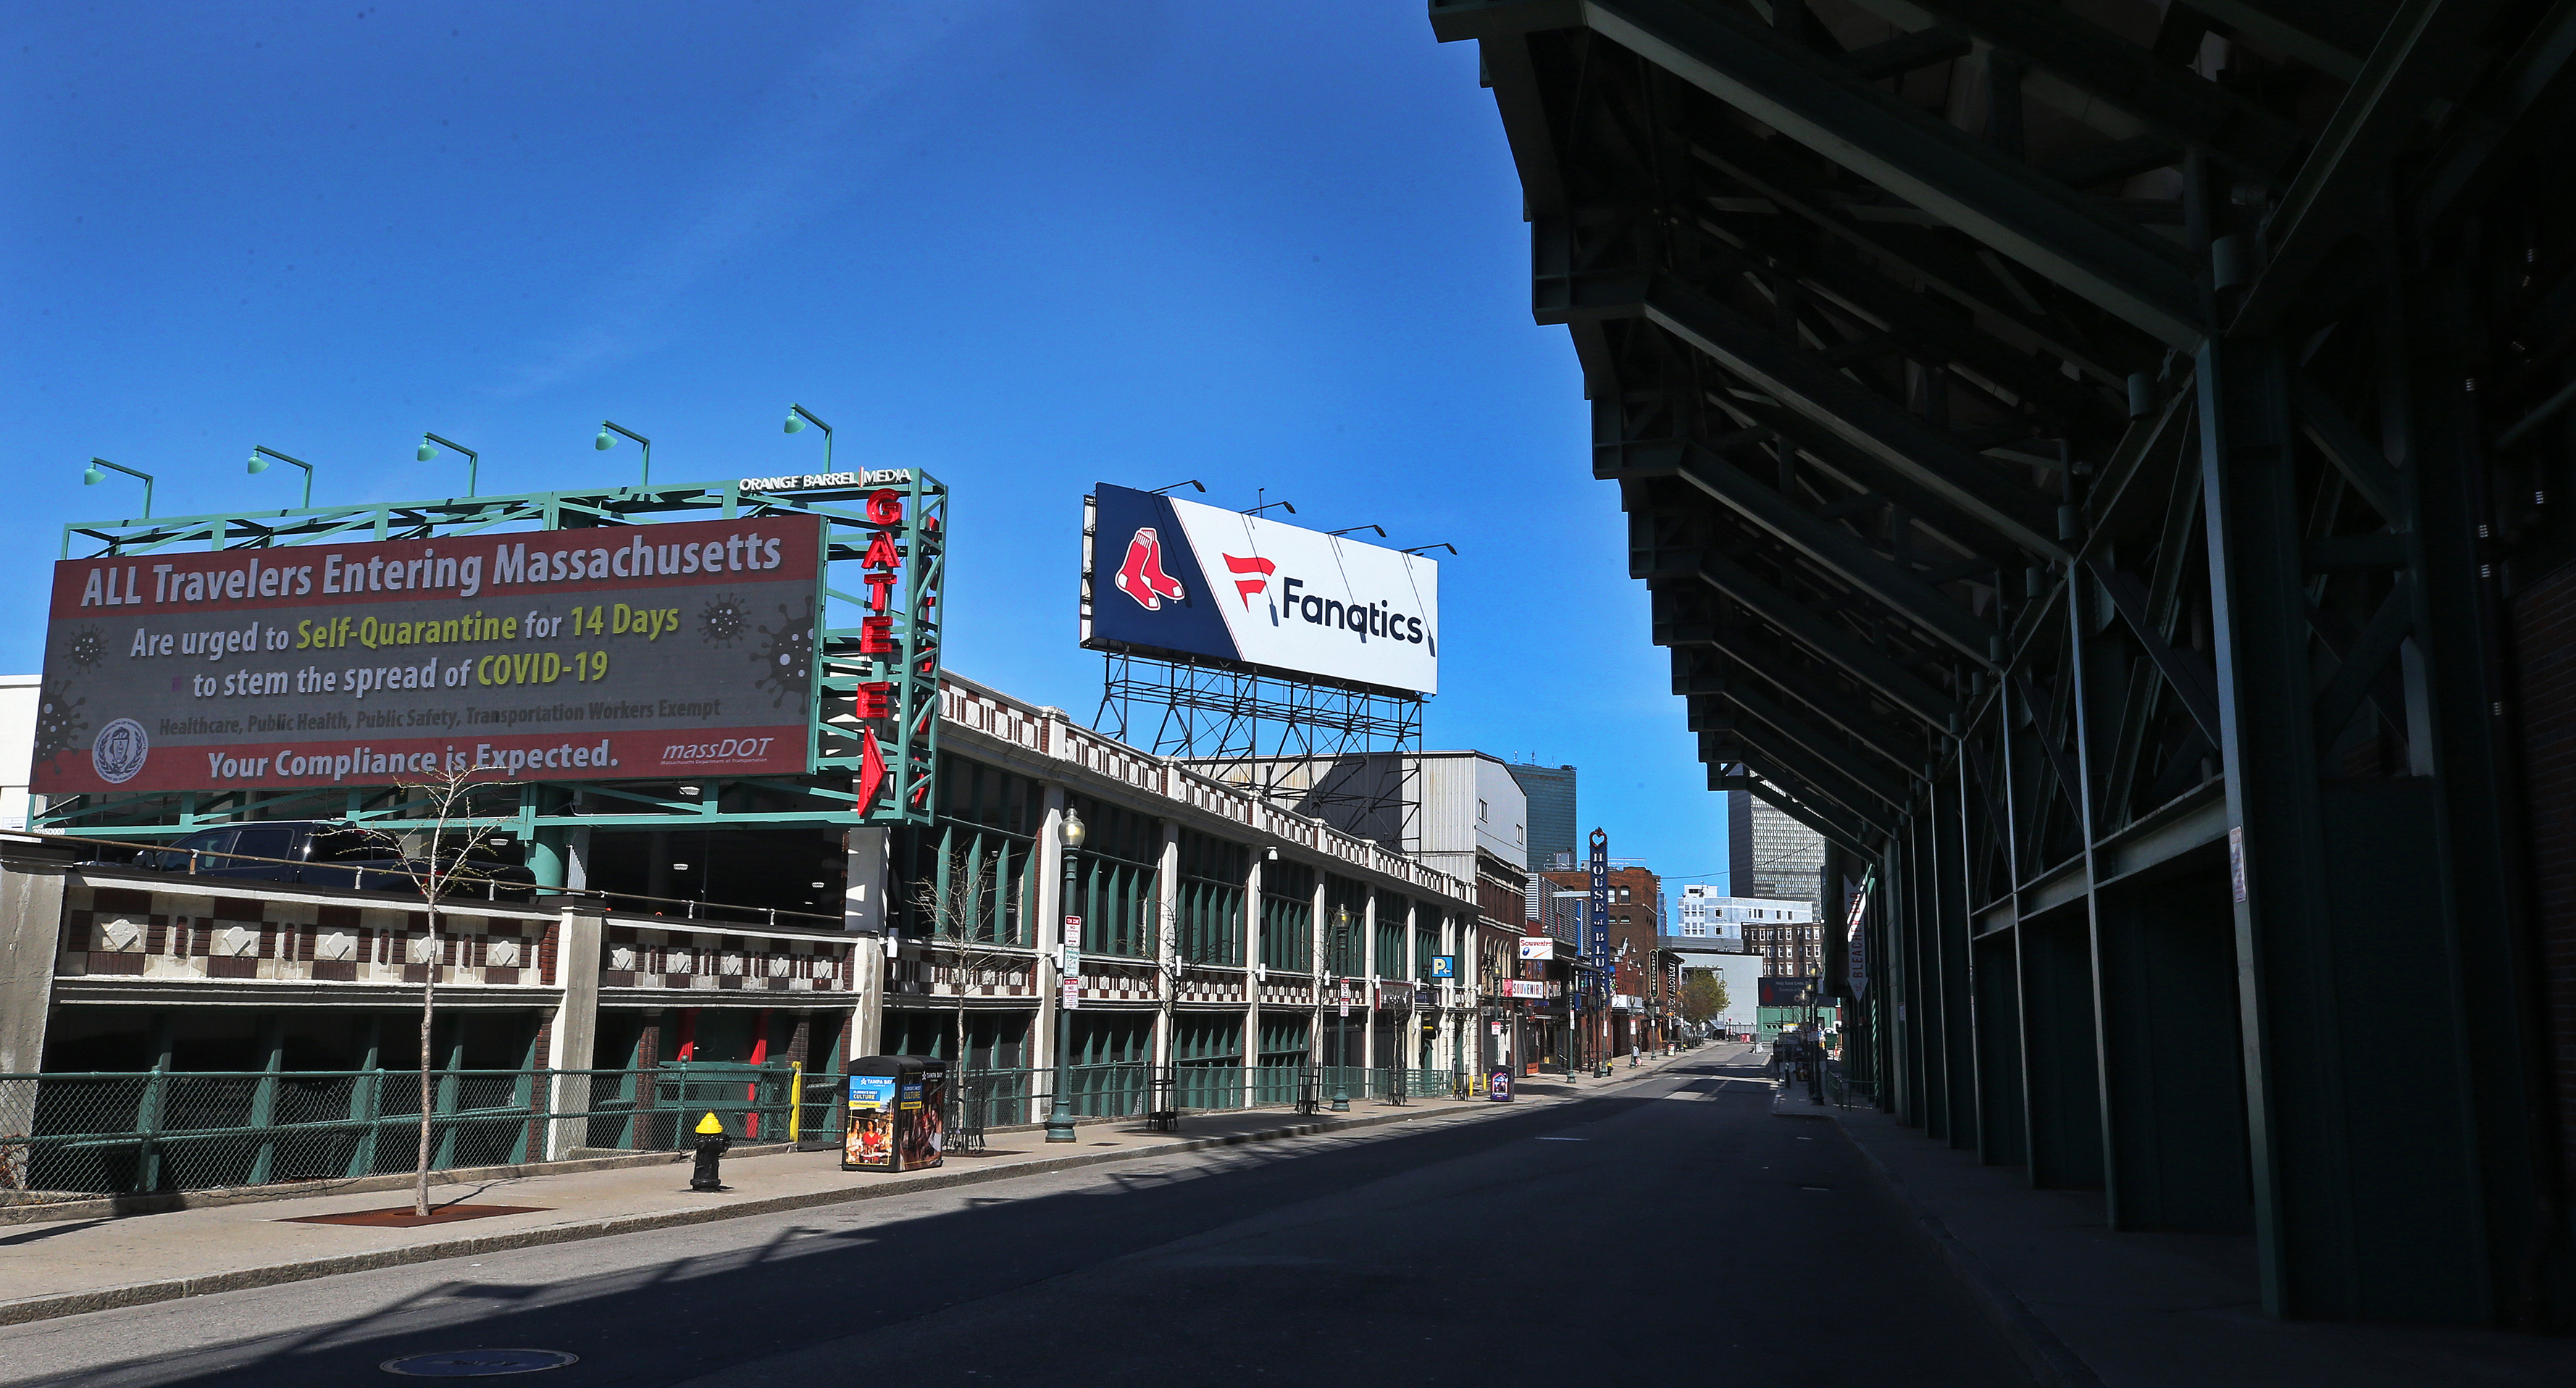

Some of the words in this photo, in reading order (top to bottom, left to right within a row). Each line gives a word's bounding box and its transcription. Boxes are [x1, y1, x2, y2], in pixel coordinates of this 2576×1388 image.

[740, 475, 802, 491] ORANGE
[803, 472, 860, 488] BARREL
[863, 468, 911, 484] MEDIA
[80, 566, 141, 607] ALL
[153, 558, 312, 603] Travelers
[322, 548, 482, 597] Entering
[493, 532, 782, 585] Massachusetts
[861, 488, 903, 653] GATE
[130, 627, 175, 657] Are
[181, 621, 259, 661] urged
[265, 627, 289, 651] to
[296, 611, 517, 651] Self-Quarantine
[524, 611, 562, 639] for
[570, 606, 603, 636] 14
[612, 603, 679, 641] Days
[1283, 576, 1423, 645] Fanatics
[193, 674, 217, 697] to
[224, 669, 288, 696] stem
[296, 666, 336, 693] the
[343, 657, 437, 698] spread
[444, 659, 472, 687] of
[477, 651, 608, 686] COVID-19
[159, 716, 243, 736] Healthcare,
[247, 713, 293, 733] Public
[296, 711, 351, 732] Health,
[357, 709, 404, 729] Public
[406, 707, 461, 729] Safety,
[466, 703, 584, 727] Transportation
[588, 700, 653, 721] Workers
[658, 698, 722, 720] Exempt
[856, 682, 890, 719] E
[208, 752, 269, 779] Your
[275, 747, 437, 782] Compliance
[445, 744, 467, 772] is
[476, 739, 619, 777] Expected.
[662, 737, 774, 758] massDOT
[1592, 853, 1605, 912] HOUSE
[1434, 958, 1446, 974] P
[1852, 920, 1863, 978] BLEACHER
[1513, 983, 1542, 995] SOUVENIRS
